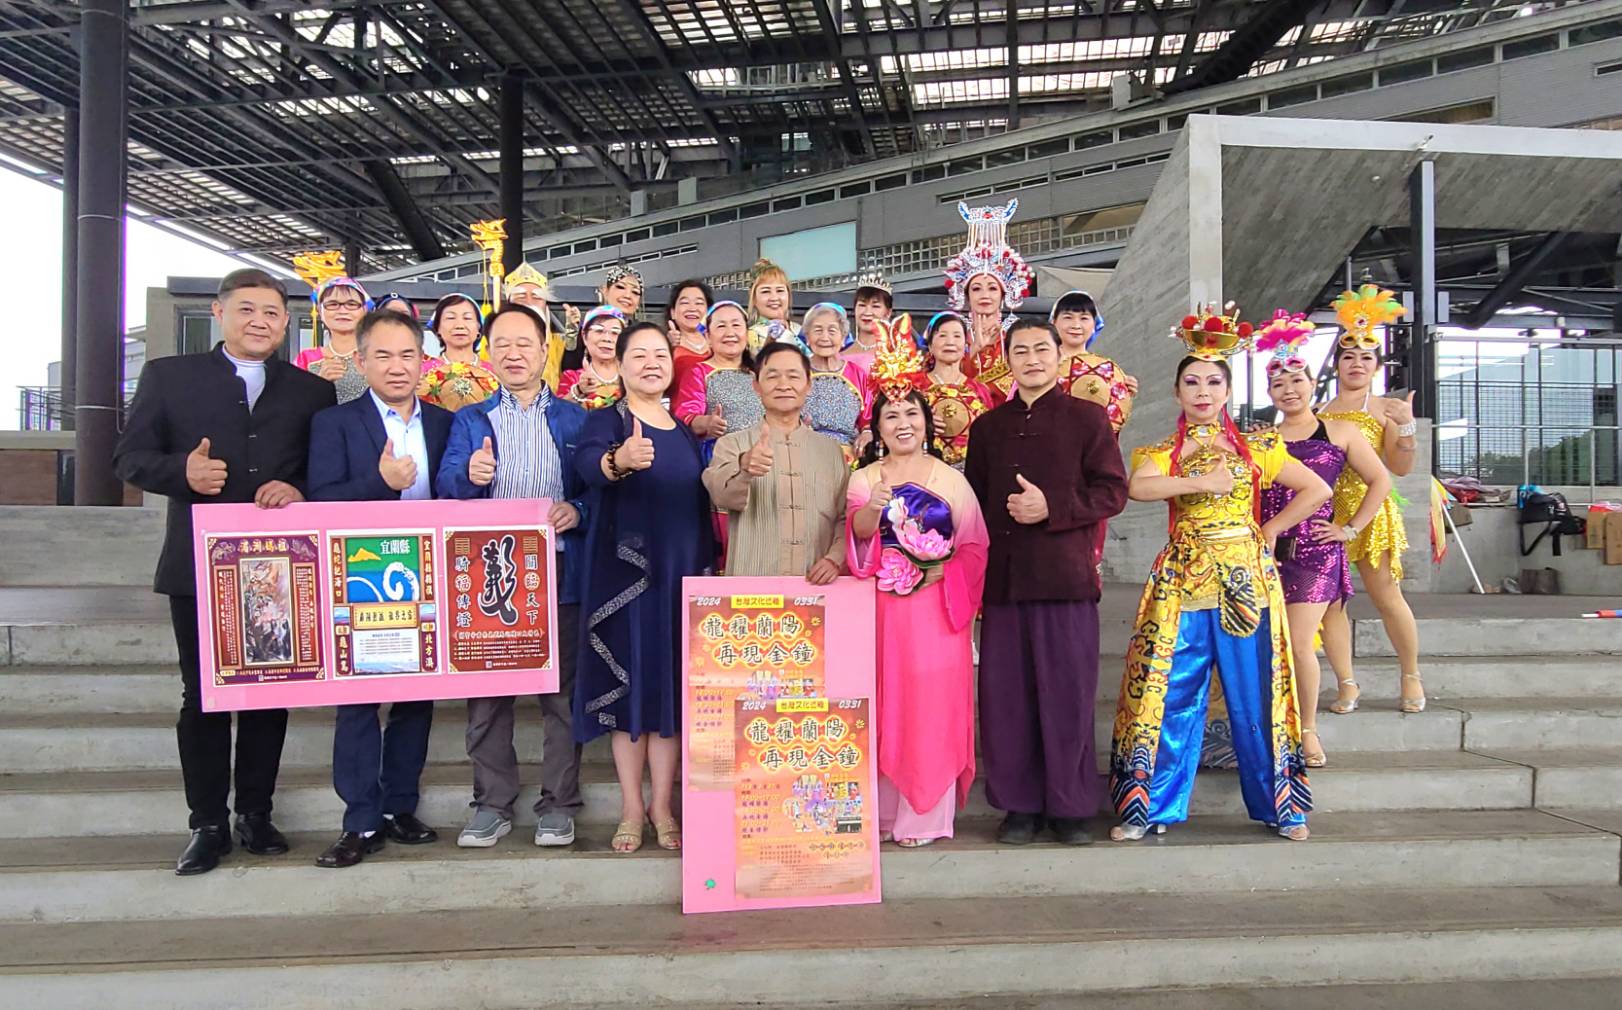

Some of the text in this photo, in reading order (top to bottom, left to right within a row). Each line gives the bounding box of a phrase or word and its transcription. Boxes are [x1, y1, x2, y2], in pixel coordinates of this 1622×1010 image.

[380, 539, 411, 555] 宜蘭縣
[696, 595, 721, 606] 2024
[704, 614, 801, 640] 龍耀蘭陽
[716, 640, 814, 665] 再現金鐘
[742, 700, 767, 711] 2024
[838, 699, 862, 710] 0331
[749, 718, 845, 743] 龍耀蘭陽
[762, 744, 860, 769] 再現金鐘
